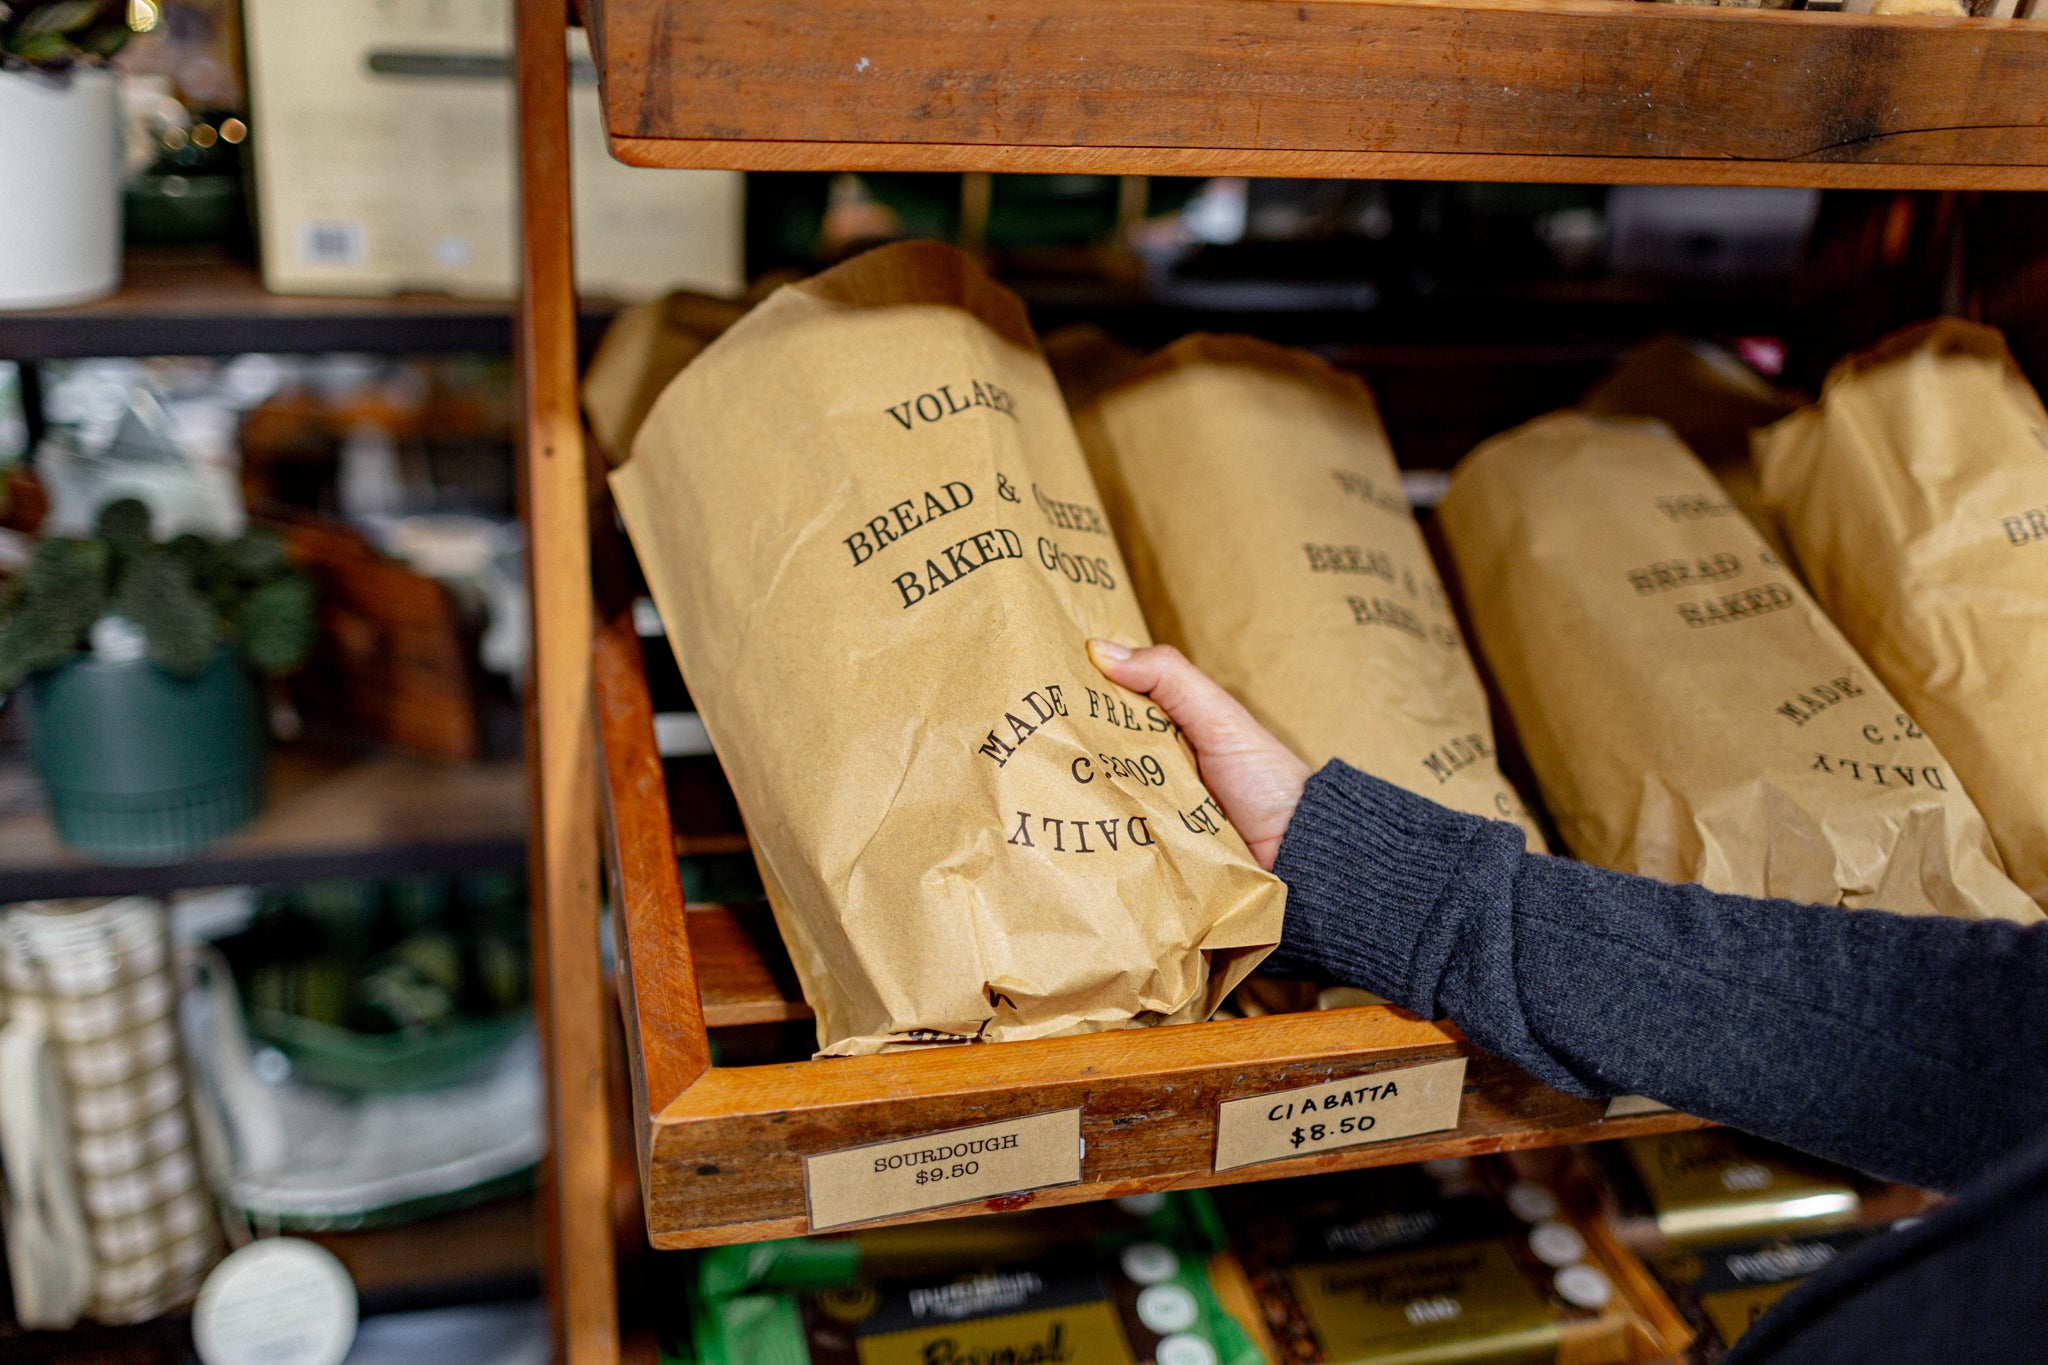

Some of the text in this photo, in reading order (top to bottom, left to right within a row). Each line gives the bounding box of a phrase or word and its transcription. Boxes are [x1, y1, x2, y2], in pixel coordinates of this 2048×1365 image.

[842, 481, 974, 567] BREAD
[996, 472, 1021, 504] &
[891, 529, 1023, 609] BAKED
[1627, 552, 1743, 597] BREAD
[1675, 582, 1794, 628] BAKED
[1776, 676, 1865, 728] MADE
[978, 684, 1183, 768] MADE FRES
[1810, 752, 1948, 792] DAILY
[1007, 811, 1156, 853] DAILY
[1267, 1081, 1399, 1122] CIABATTA
[874, 1133, 1019, 1173] SOURDOUGH
[1290, 1115, 1376, 1149] $8.50
[915, 1160, 980, 1186] $9.50
